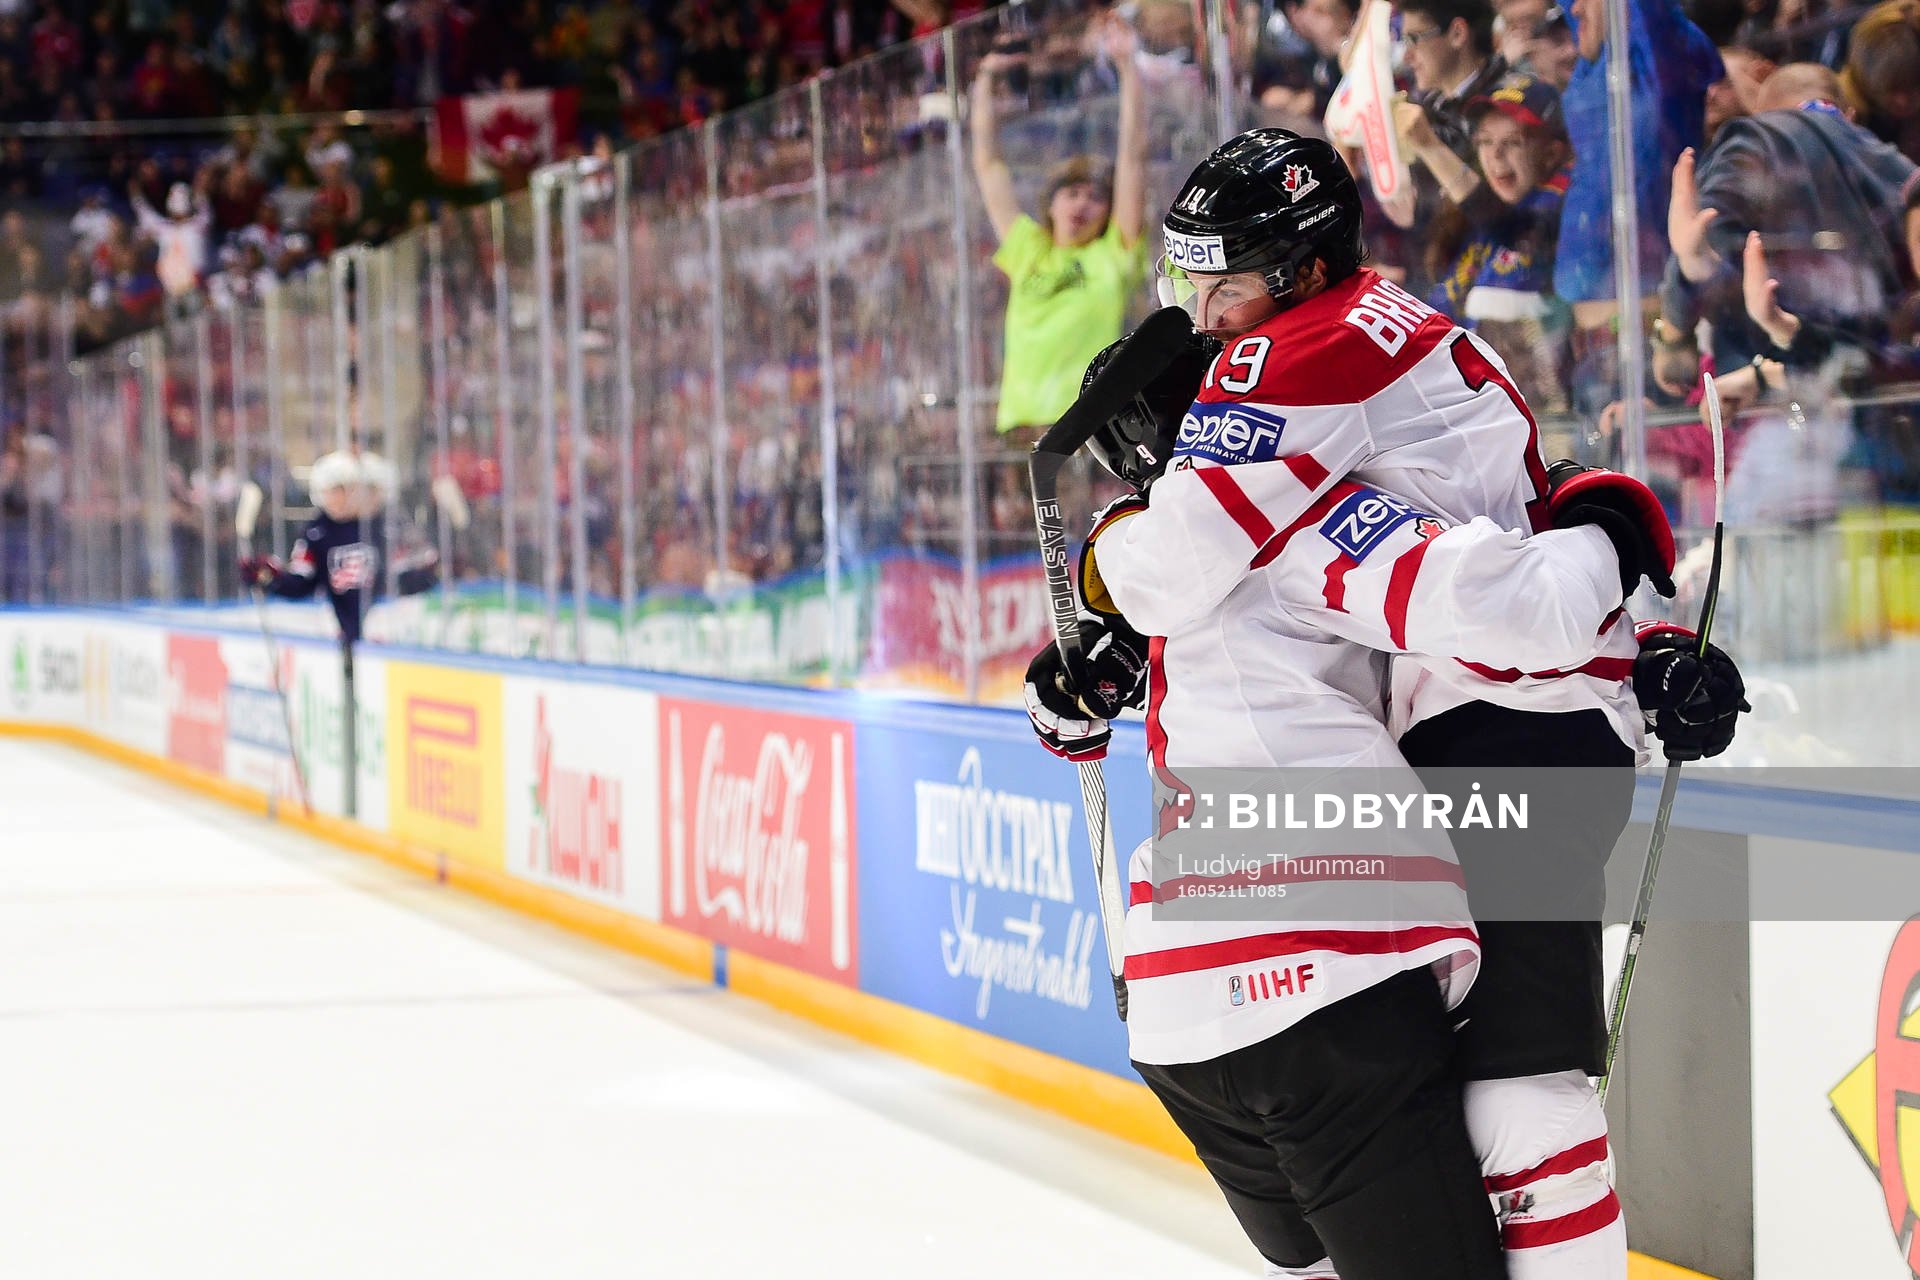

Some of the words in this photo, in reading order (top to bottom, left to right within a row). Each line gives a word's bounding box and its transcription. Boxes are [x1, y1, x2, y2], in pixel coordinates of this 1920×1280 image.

[1298, 205, 1336, 231] BAUER
[1164, 236, 1221, 265] epter
[1205, 336, 1271, 394] 19
[1178, 410, 1280, 457] epter
[1136, 444, 1157, 465] 9
[1329, 494, 1411, 544] zep
[1036, 498, 1081, 641] EASTON
[1662, 656, 1681, 691] CCM
[1247, 963, 1315, 1002] IIHF
